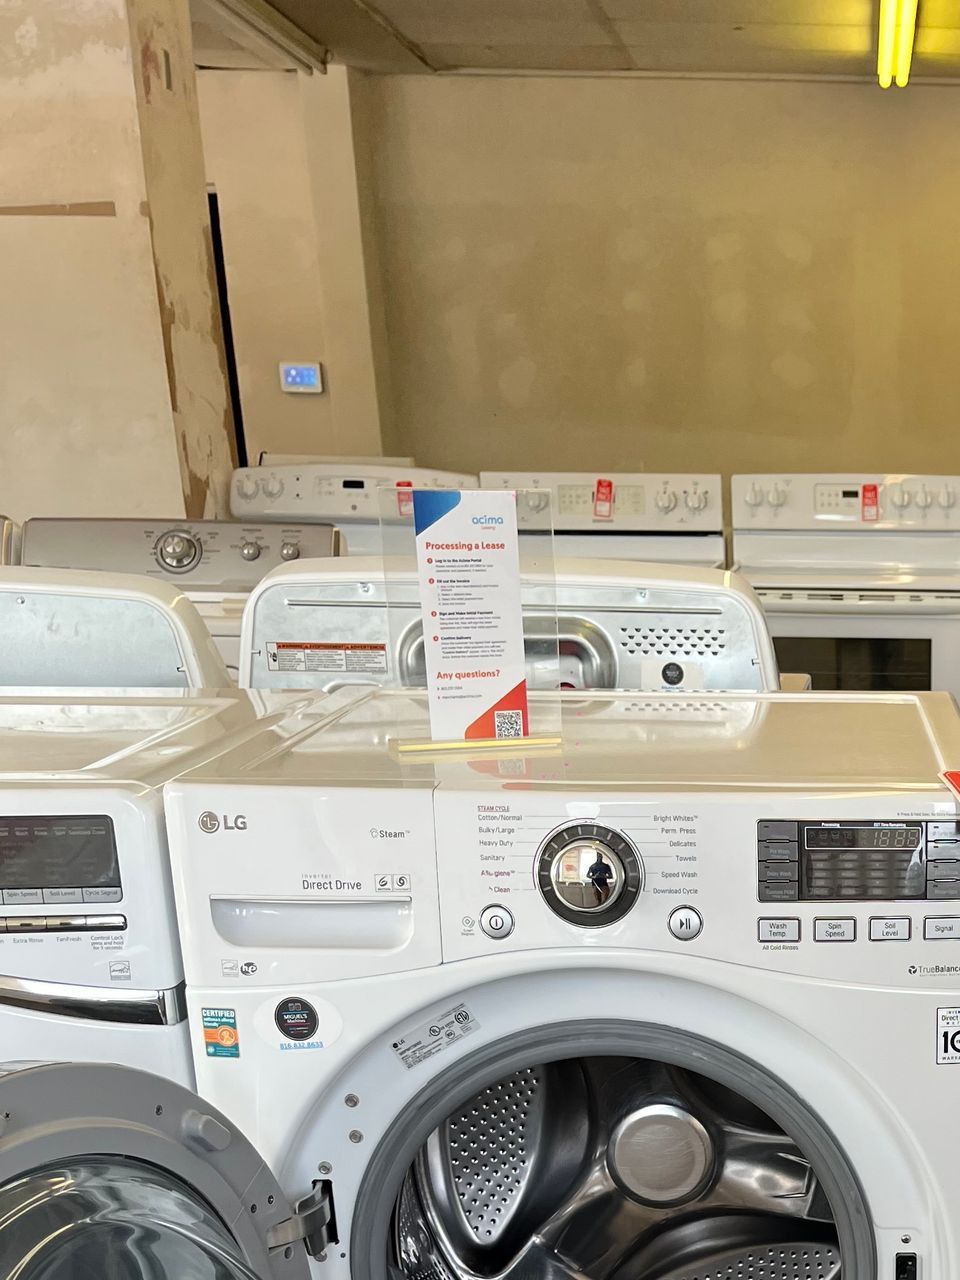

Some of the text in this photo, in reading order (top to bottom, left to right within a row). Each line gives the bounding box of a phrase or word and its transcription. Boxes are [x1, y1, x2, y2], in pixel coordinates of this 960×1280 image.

[472, 515, 504, 524] acima
[426, 542, 472, 551] Processing
[437, 670, 500, 680] Any questions?
[224, 815, 247, 830] LG
[302, 880, 362, 890] Direct Drive
